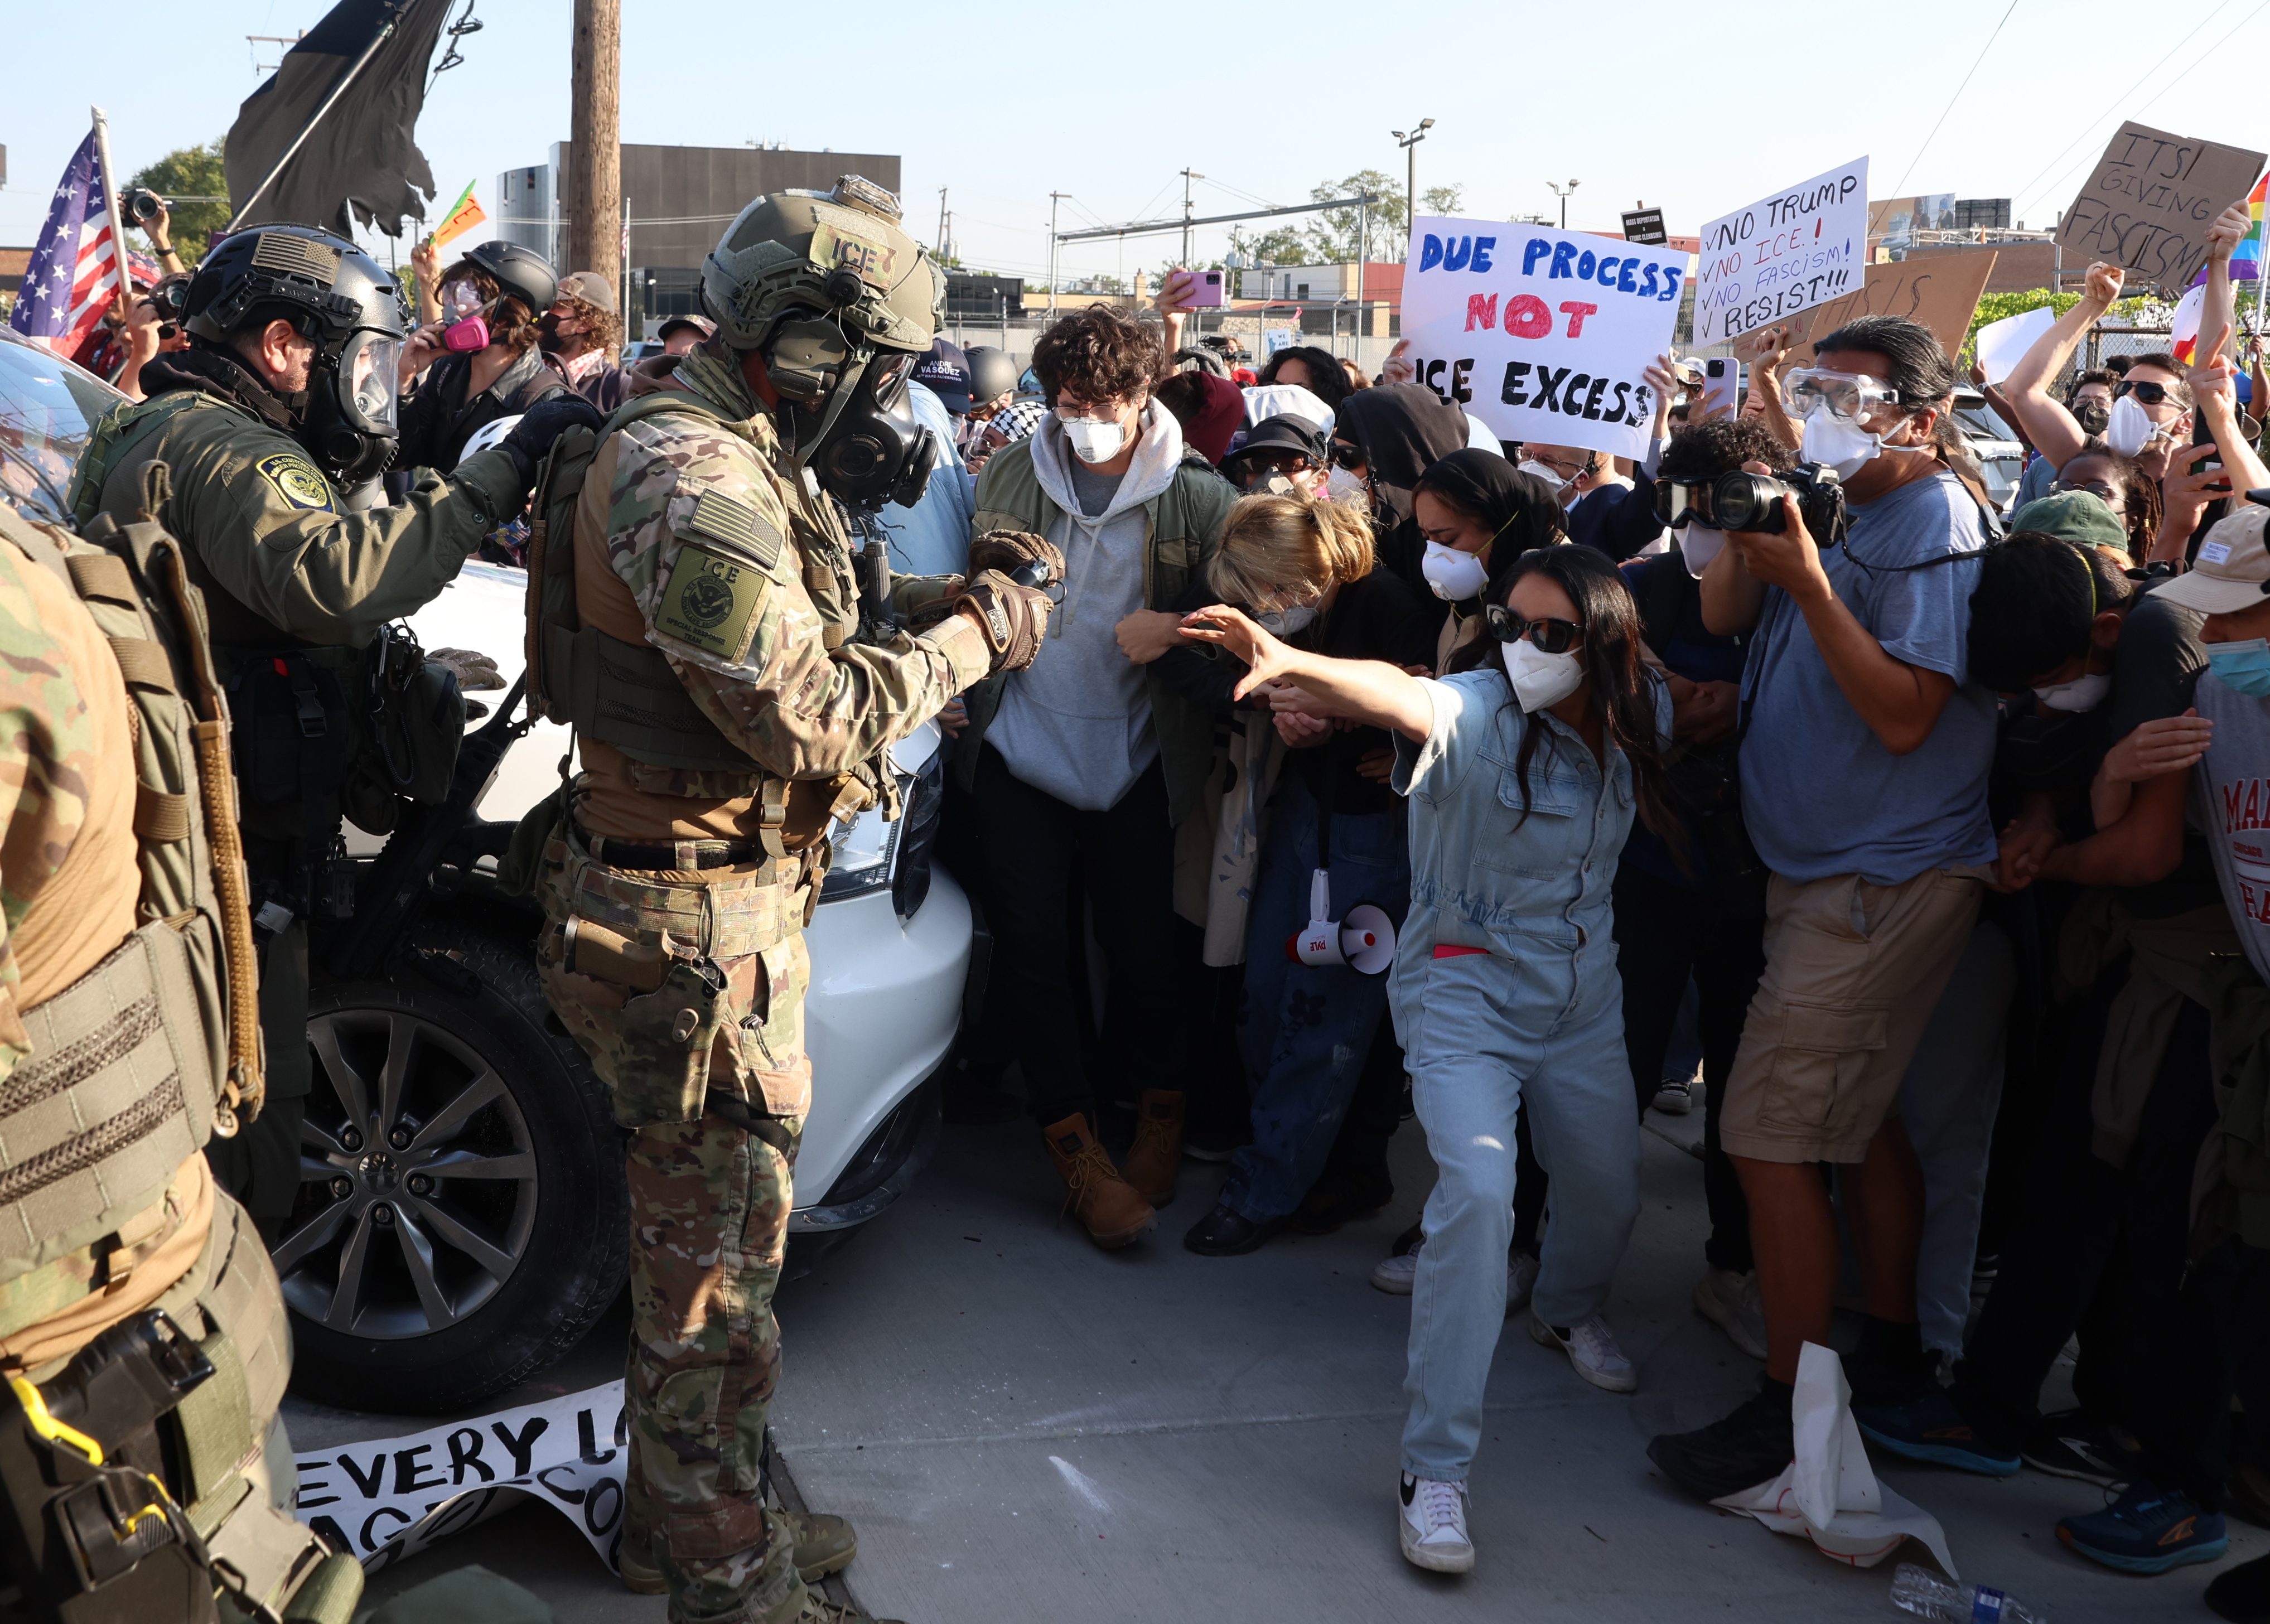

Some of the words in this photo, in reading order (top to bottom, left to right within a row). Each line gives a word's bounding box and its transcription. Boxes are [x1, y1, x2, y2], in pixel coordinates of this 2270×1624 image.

[2108, 132, 2191, 179] IT'S
[2100, 169, 2210, 220] GIVING
[1636, 215, 1660, 224] DEPORTATION
[1718, 212, 1755, 251] NO
[1767, 175, 1857, 228] TRUMP
[832, 237, 877, 273] ICE
[2064, 196, 2204, 288] FASCISM
[1419, 233, 1497, 273] DUE
[1522, 238, 1683, 302] PROCESS
[1715, 252, 1741, 282] NO
[1714, 283, 1741, 307] NO
[1725, 268, 1849, 337] RESIST!!!
[1464, 292, 1598, 339] NOT
[921, 366, 960, 376] VASQUEZ
[1416, 358, 1475, 406] ICE
[1500, 360, 1654, 428] EXCESS
[282, 458, 310, 470] CUSTOMS
[288, 463, 323, 484] PROTECTION
[701, 557, 740, 583] ICE
[666, 617, 693, 632] SPECIAL
[693, 626, 726, 645] RESPONSE
[684, 632, 702, 645] TEAM
[2233, 840, 2263, 858] CHICAGO
[1310, 940, 1326, 951] PYLE
[297, 1417, 549, 1508] EVERY
